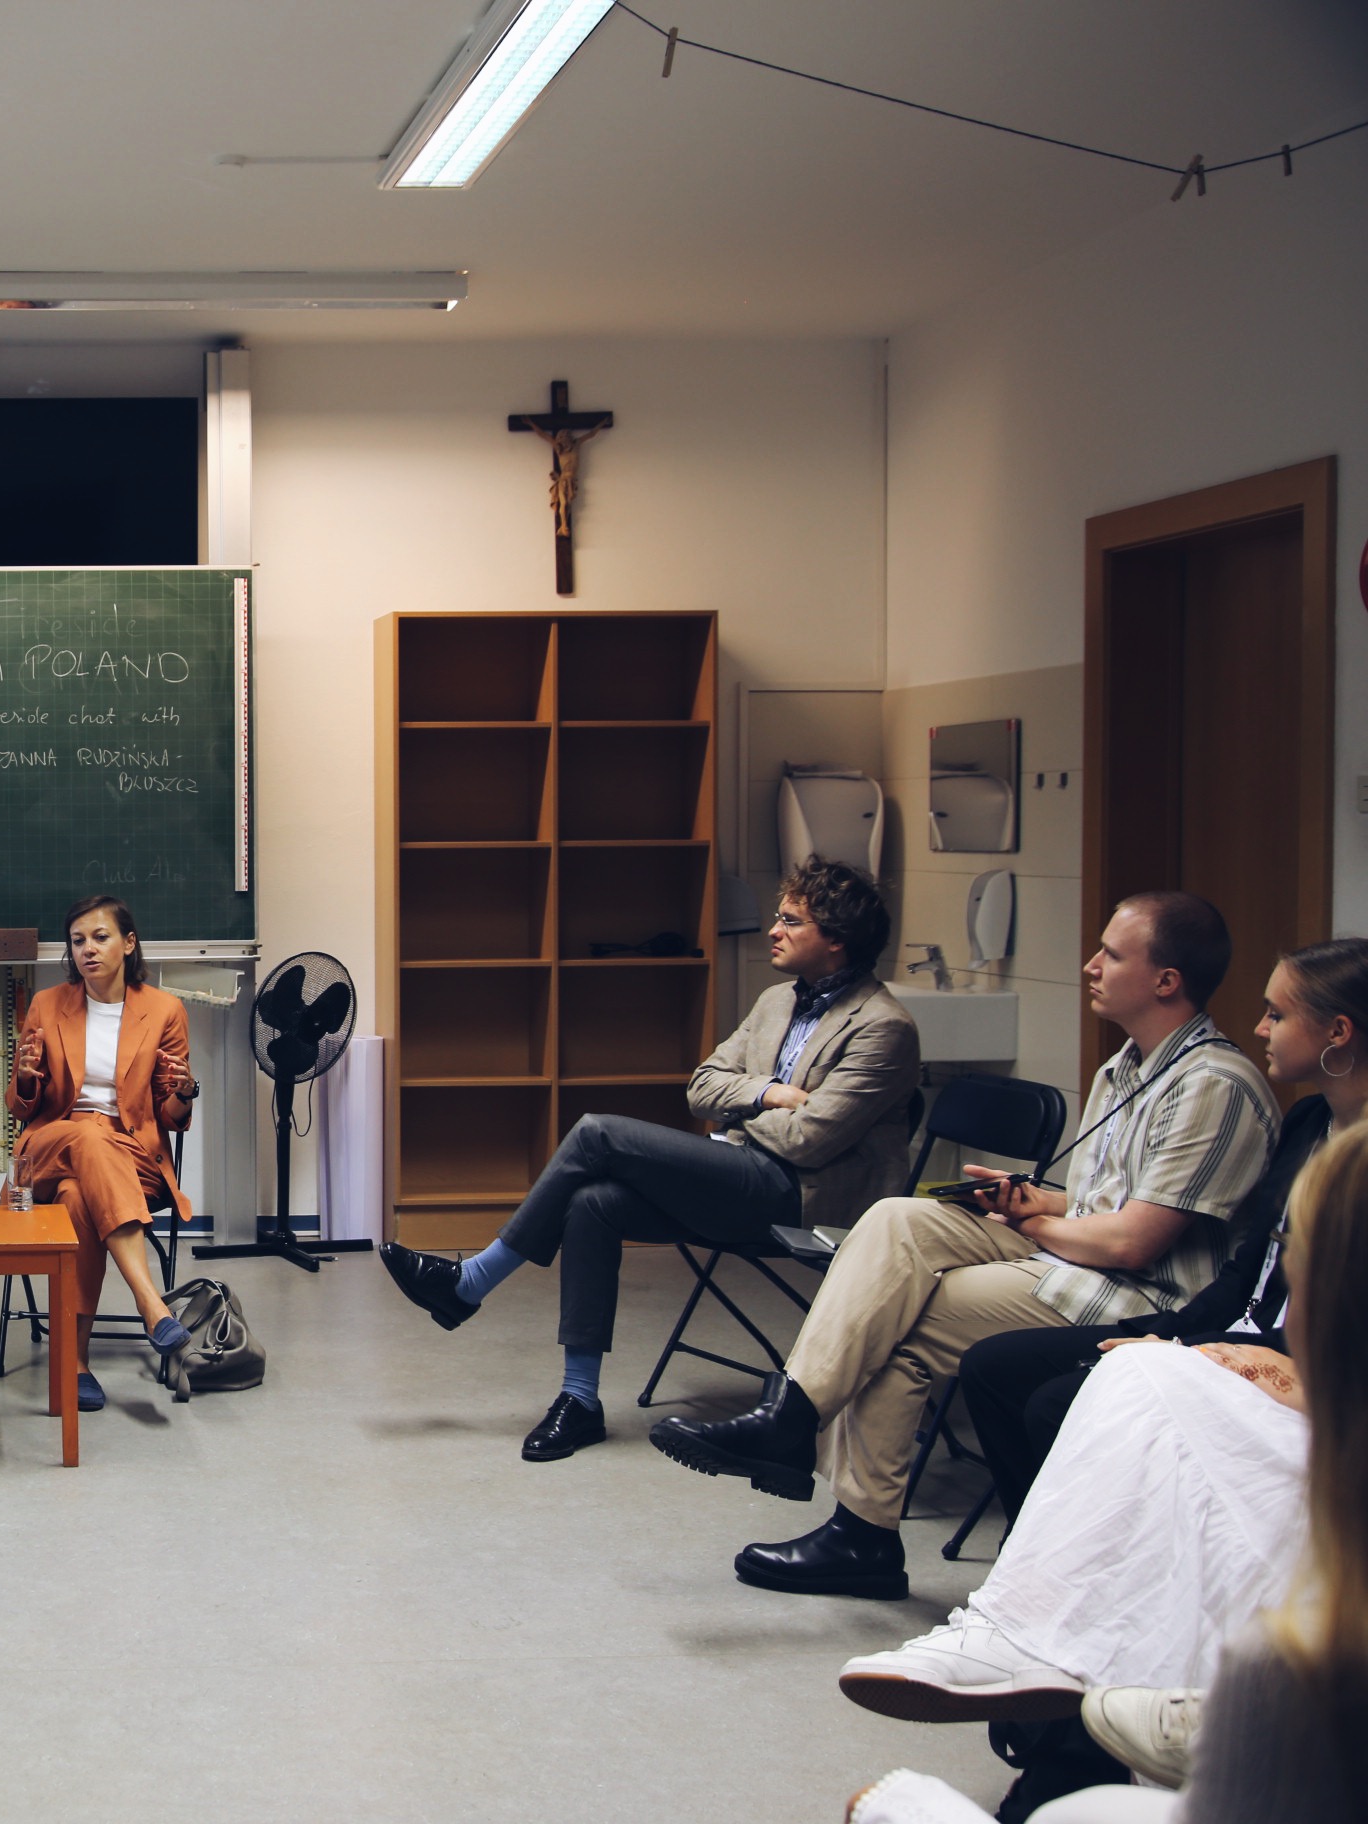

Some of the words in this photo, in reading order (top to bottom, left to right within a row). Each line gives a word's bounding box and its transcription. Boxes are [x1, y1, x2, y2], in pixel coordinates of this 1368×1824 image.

[24, 643, 189, 683] POLAND
[68, 705, 117, 725] chat
[141, 706, 180, 726] with
